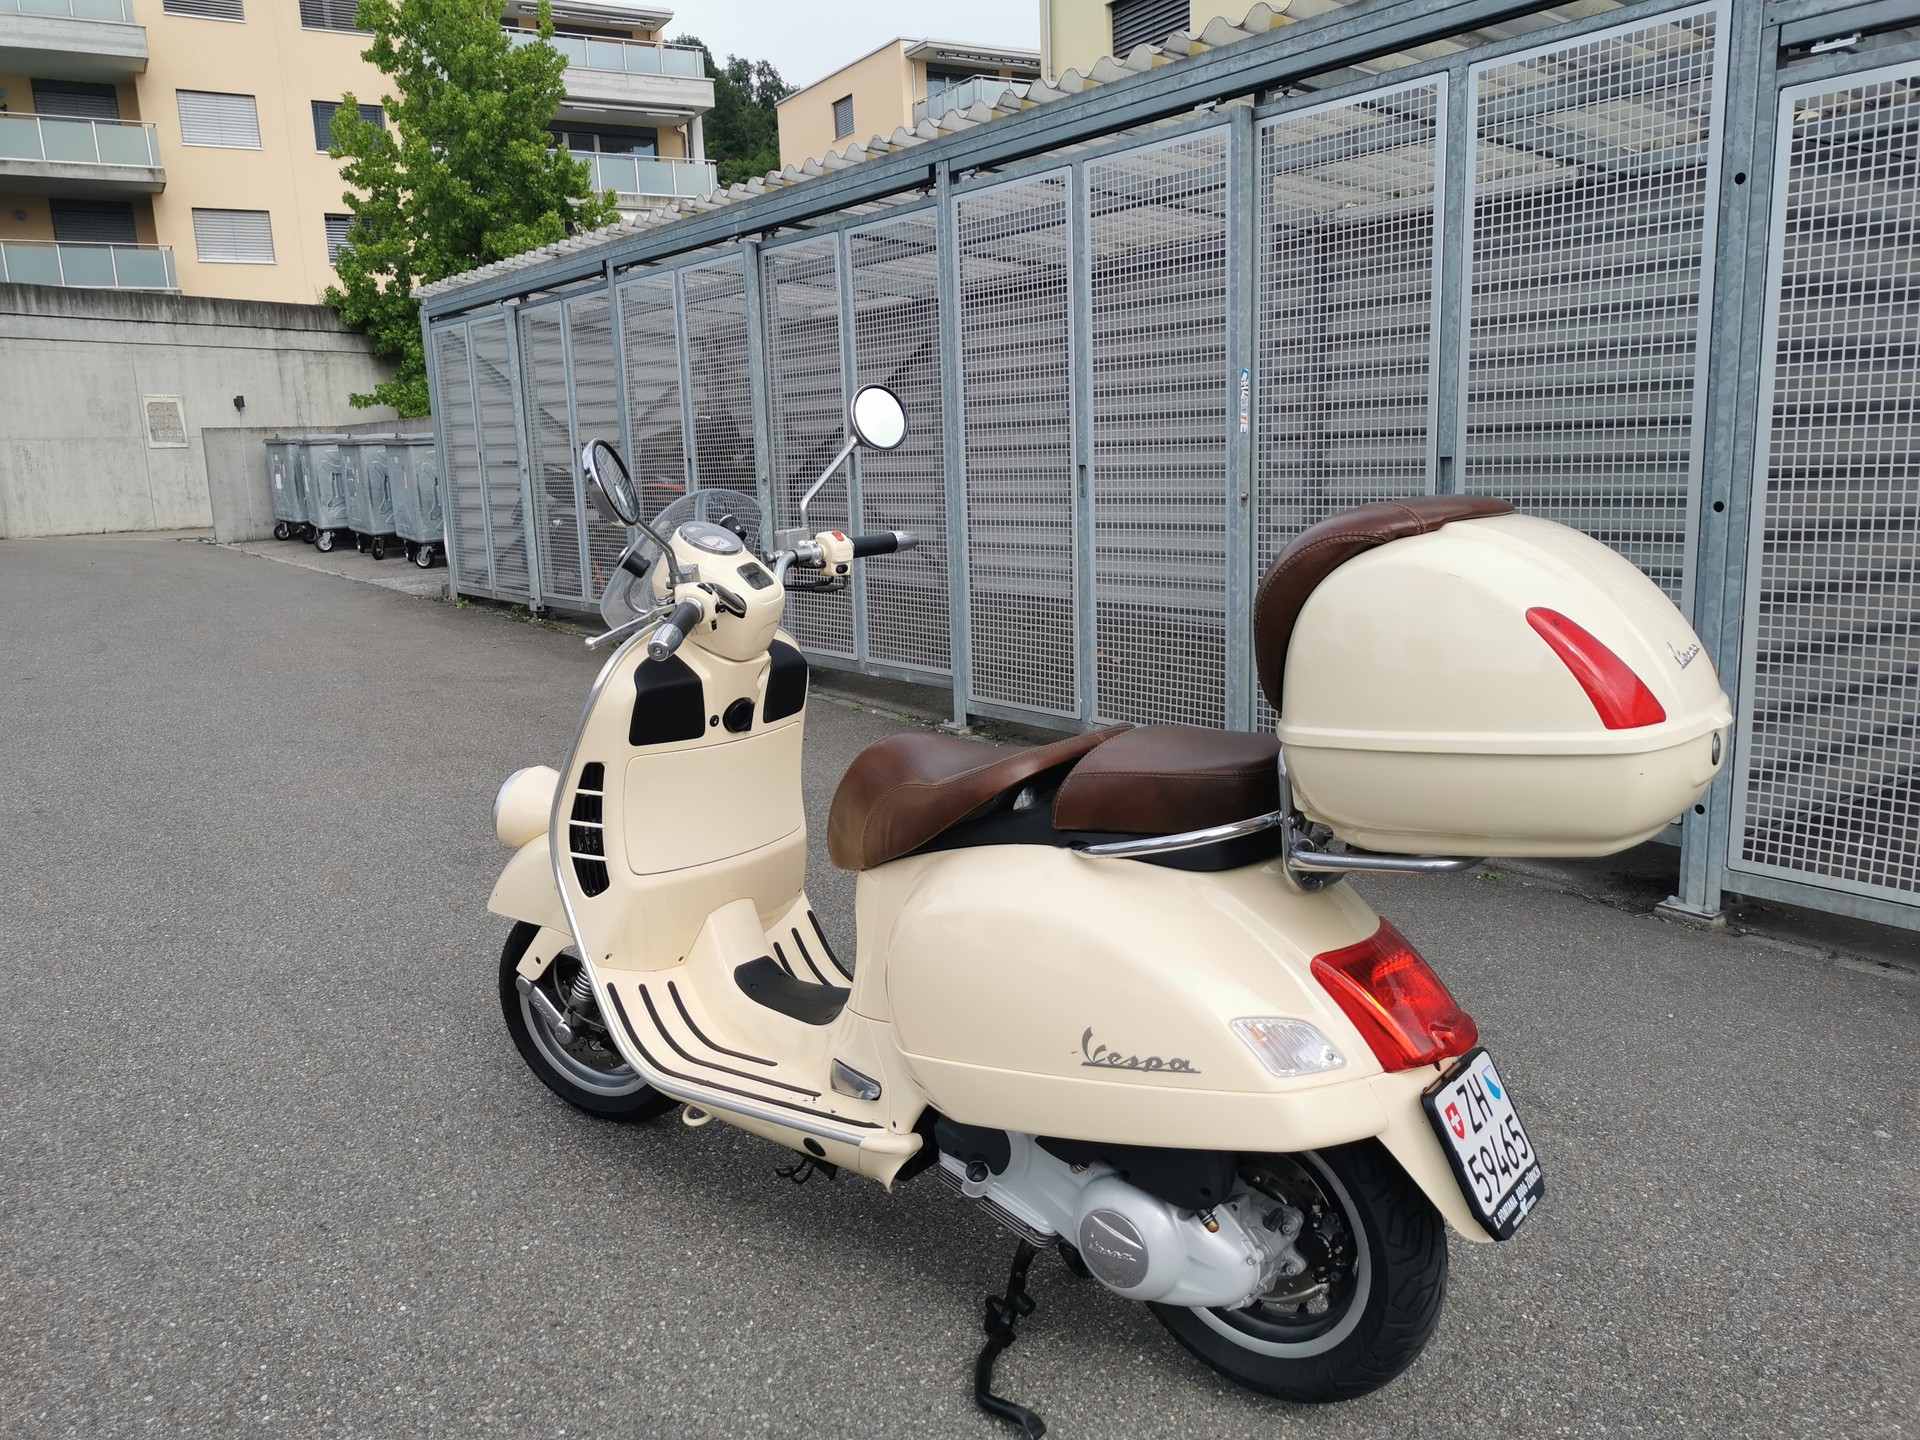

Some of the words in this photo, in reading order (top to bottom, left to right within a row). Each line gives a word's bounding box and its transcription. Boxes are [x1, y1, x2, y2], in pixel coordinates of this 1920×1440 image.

[1081, 1026, 1201, 1073] Vespa
[1456, 1073, 1493, 1135] ZH
[1468, 1113, 1528, 1204] 59465
